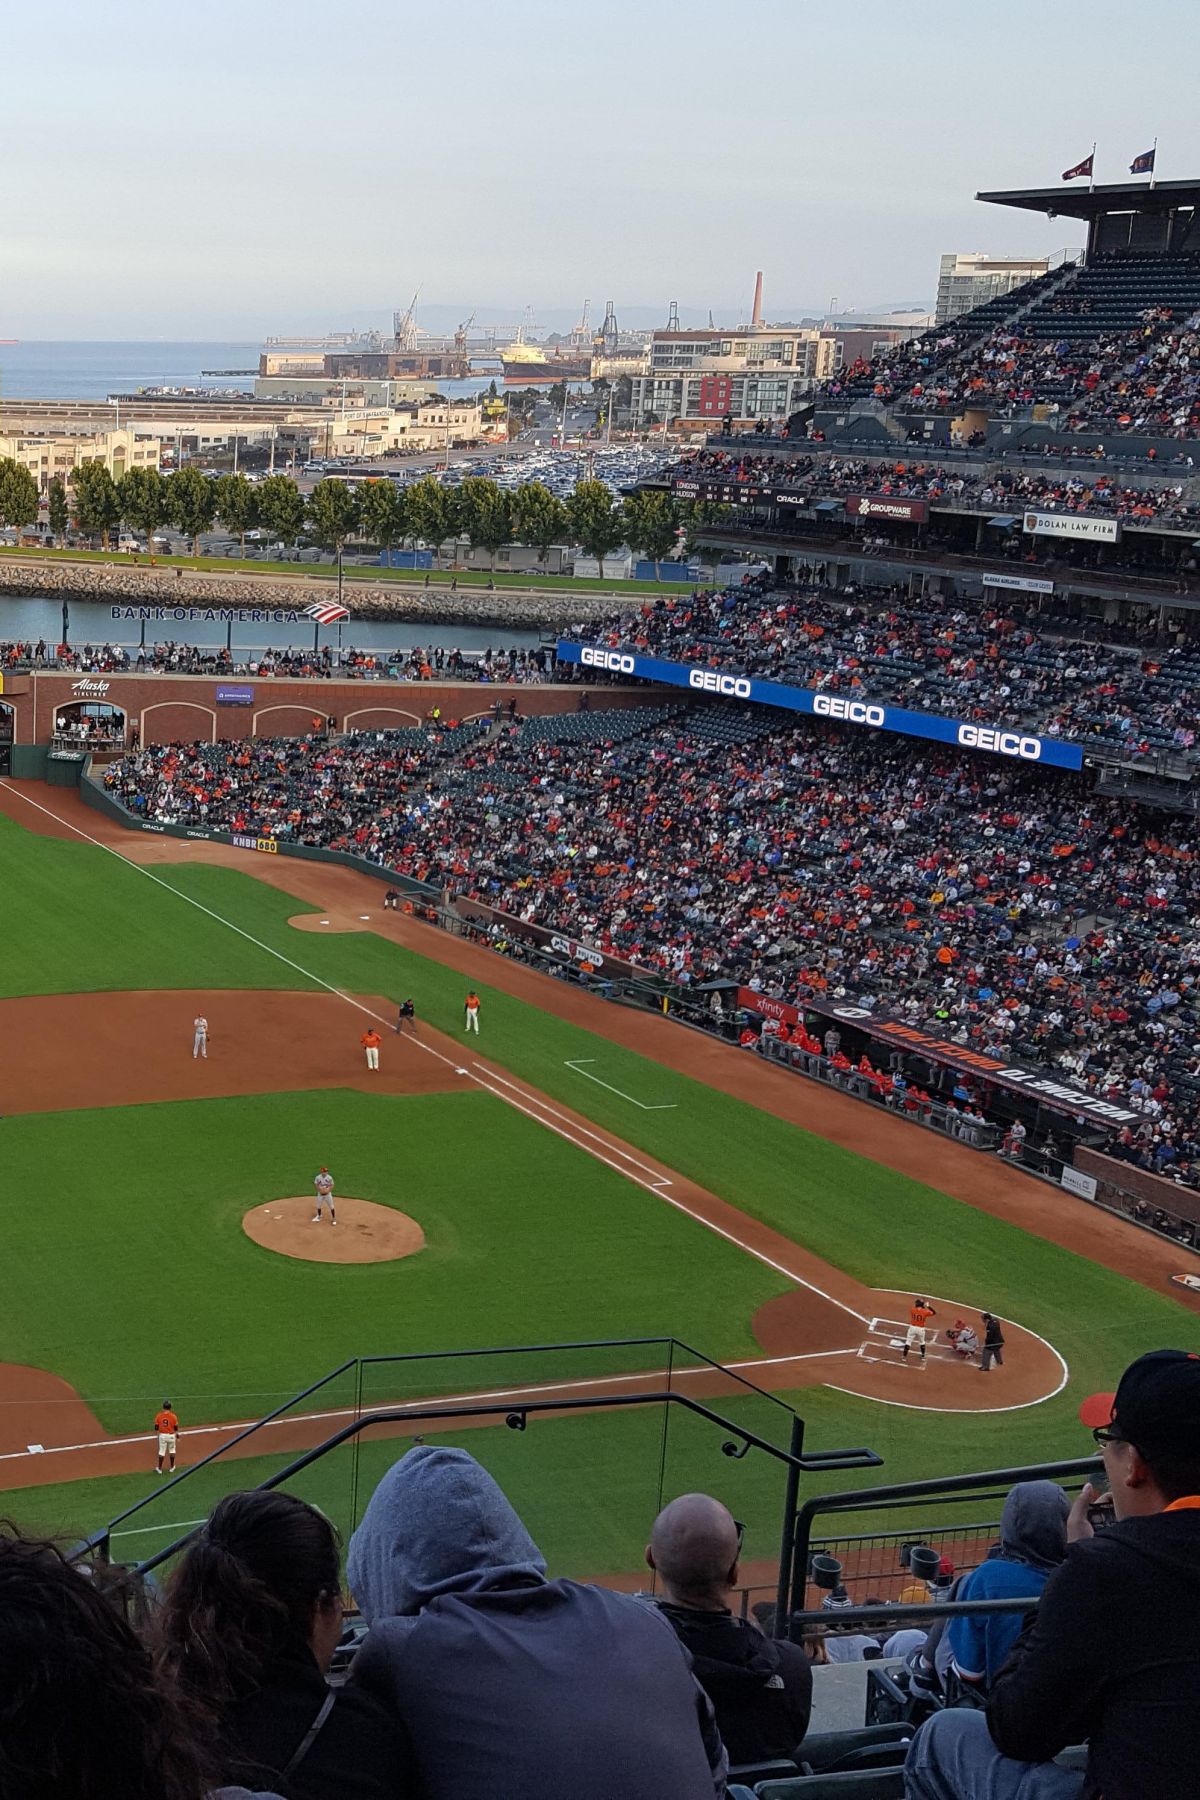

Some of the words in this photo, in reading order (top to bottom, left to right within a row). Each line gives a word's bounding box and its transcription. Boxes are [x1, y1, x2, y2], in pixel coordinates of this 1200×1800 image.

[676, 481, 699, 490] LONGORIA
[776, 495, 804, 504] ORACLE
[870, 504, 911, 514] GROUPWARE
[1038, 520, 1067, 529] DOLAN
[1071, 523, 1089, 531] LAW
[1093, 526, 1114, 534] FIRM
[111, 606, 167, 620] BANK
[173, 607, 198, 621] OF
[204, 608, 298, 623] AMERICA
[581, 647, 634, 674] GEICO
[71, 679, 110, 691] Alaska
[689, 669, 751, 698] GEICO
[813, 694, 885, 726] GEICO
[958, 725, 1042, 760] GEICO
[187, 831, 210, 839] ORACLE
[233, 837, 257, 848] KNBR
[259, 842, 275, 851] 680
[756, 998, 784, 1016] xfinity
[873, 1022, 935, 1042] PARK
[921, 1041, 1007, 1070] ORACLE
[996, 1069, 1036, 1081] TO
[1024, 1080, 1139, 1120] WELCOME
